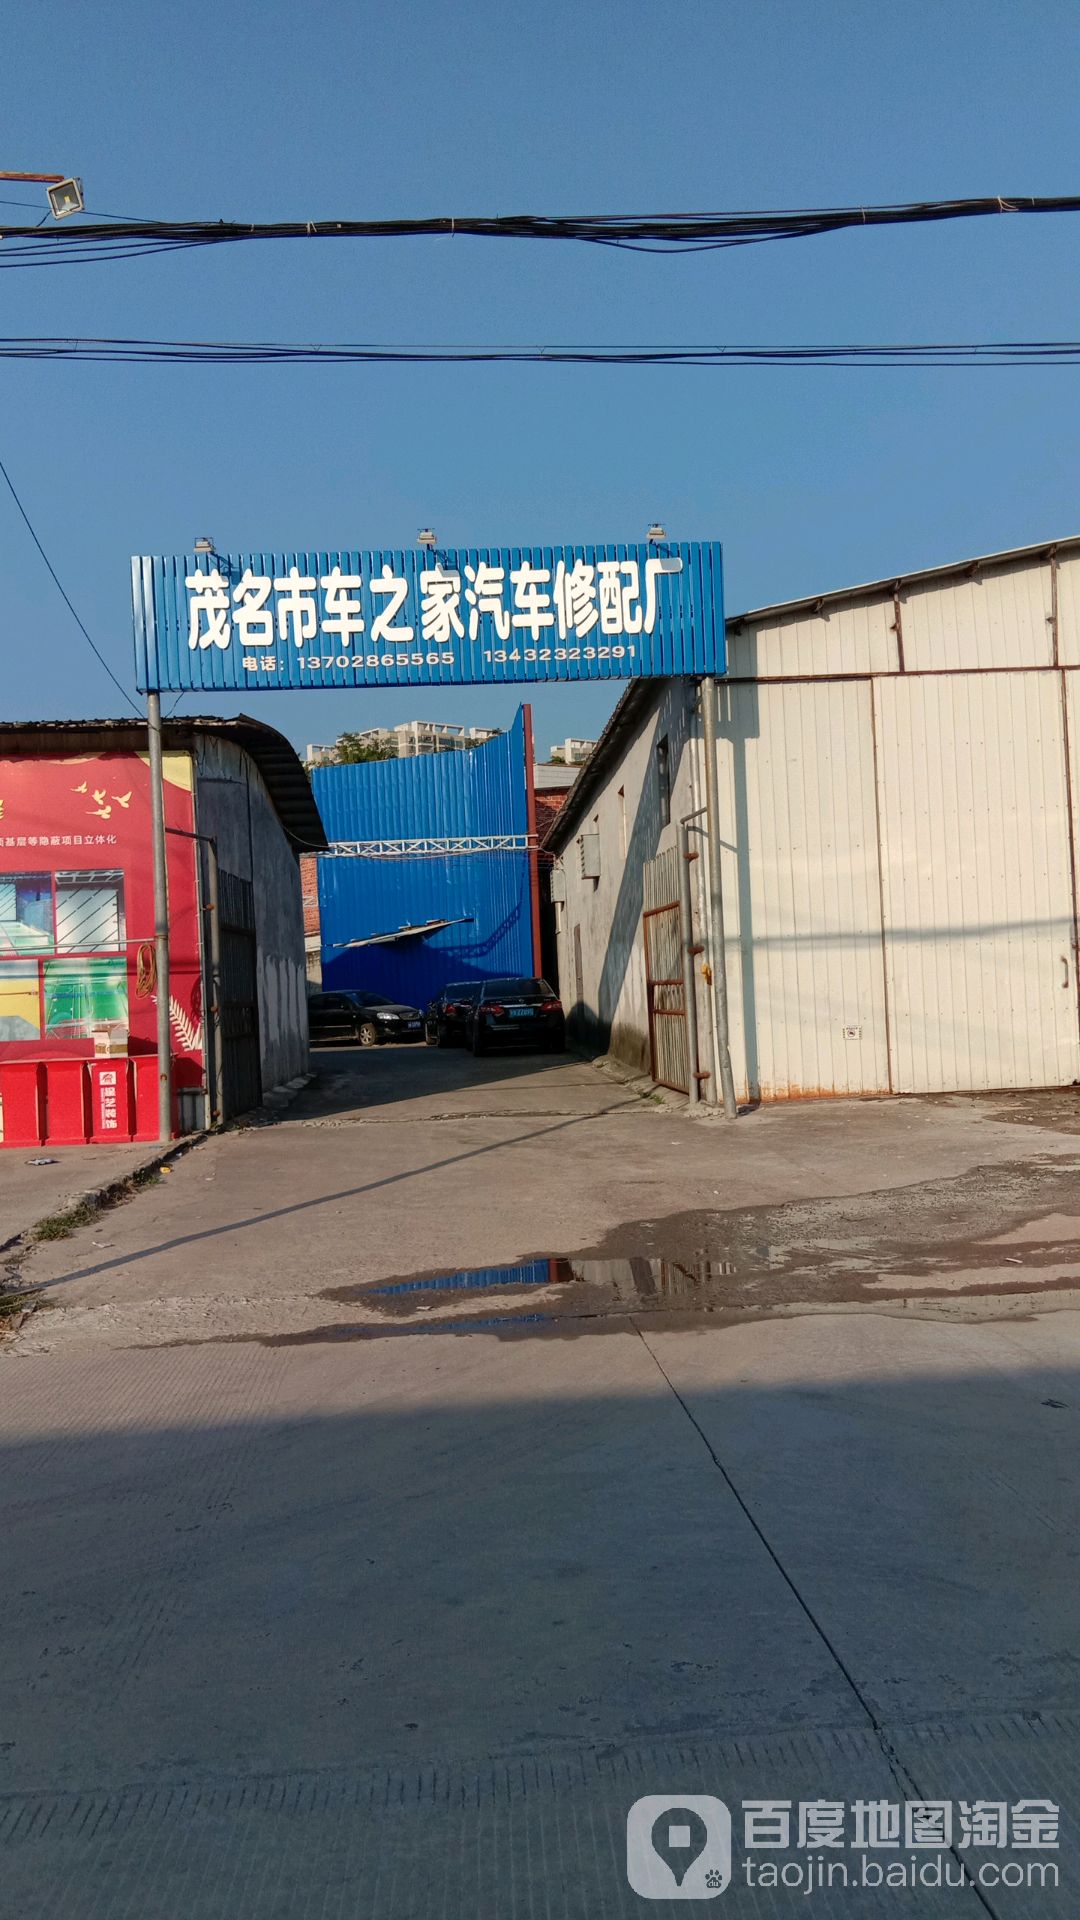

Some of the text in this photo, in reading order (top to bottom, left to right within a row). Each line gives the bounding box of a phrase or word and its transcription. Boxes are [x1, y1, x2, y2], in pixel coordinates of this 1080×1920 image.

[185, 557, 683, 650] 茂名市车之家汽车修配厂
[484, 645, 636, 663] 13432323291
